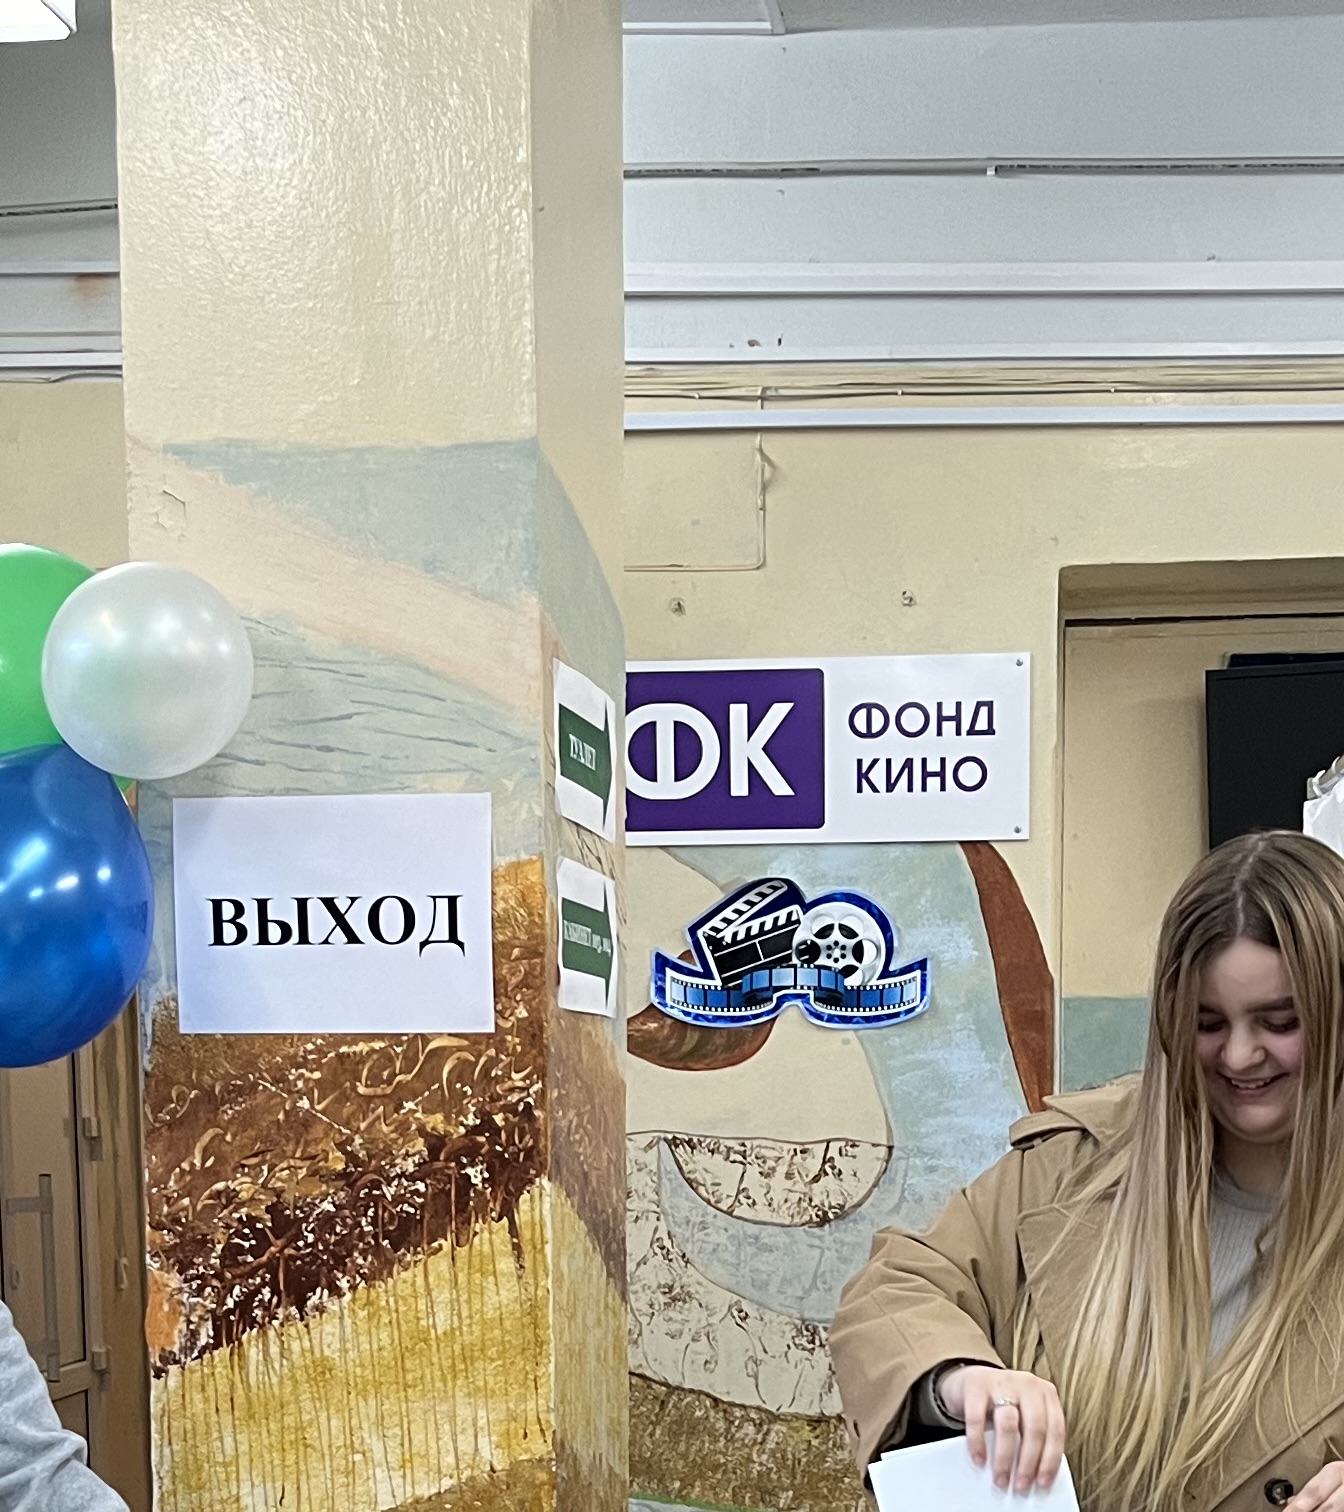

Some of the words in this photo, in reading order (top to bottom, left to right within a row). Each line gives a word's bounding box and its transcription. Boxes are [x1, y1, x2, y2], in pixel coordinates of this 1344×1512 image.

[848, 700, 996, 739] ФОНД
[625, 702, 795, 800] ФК
[856, 755, 988, 794] КИНО
[206, 895, 466, 957] ВЫХОД
